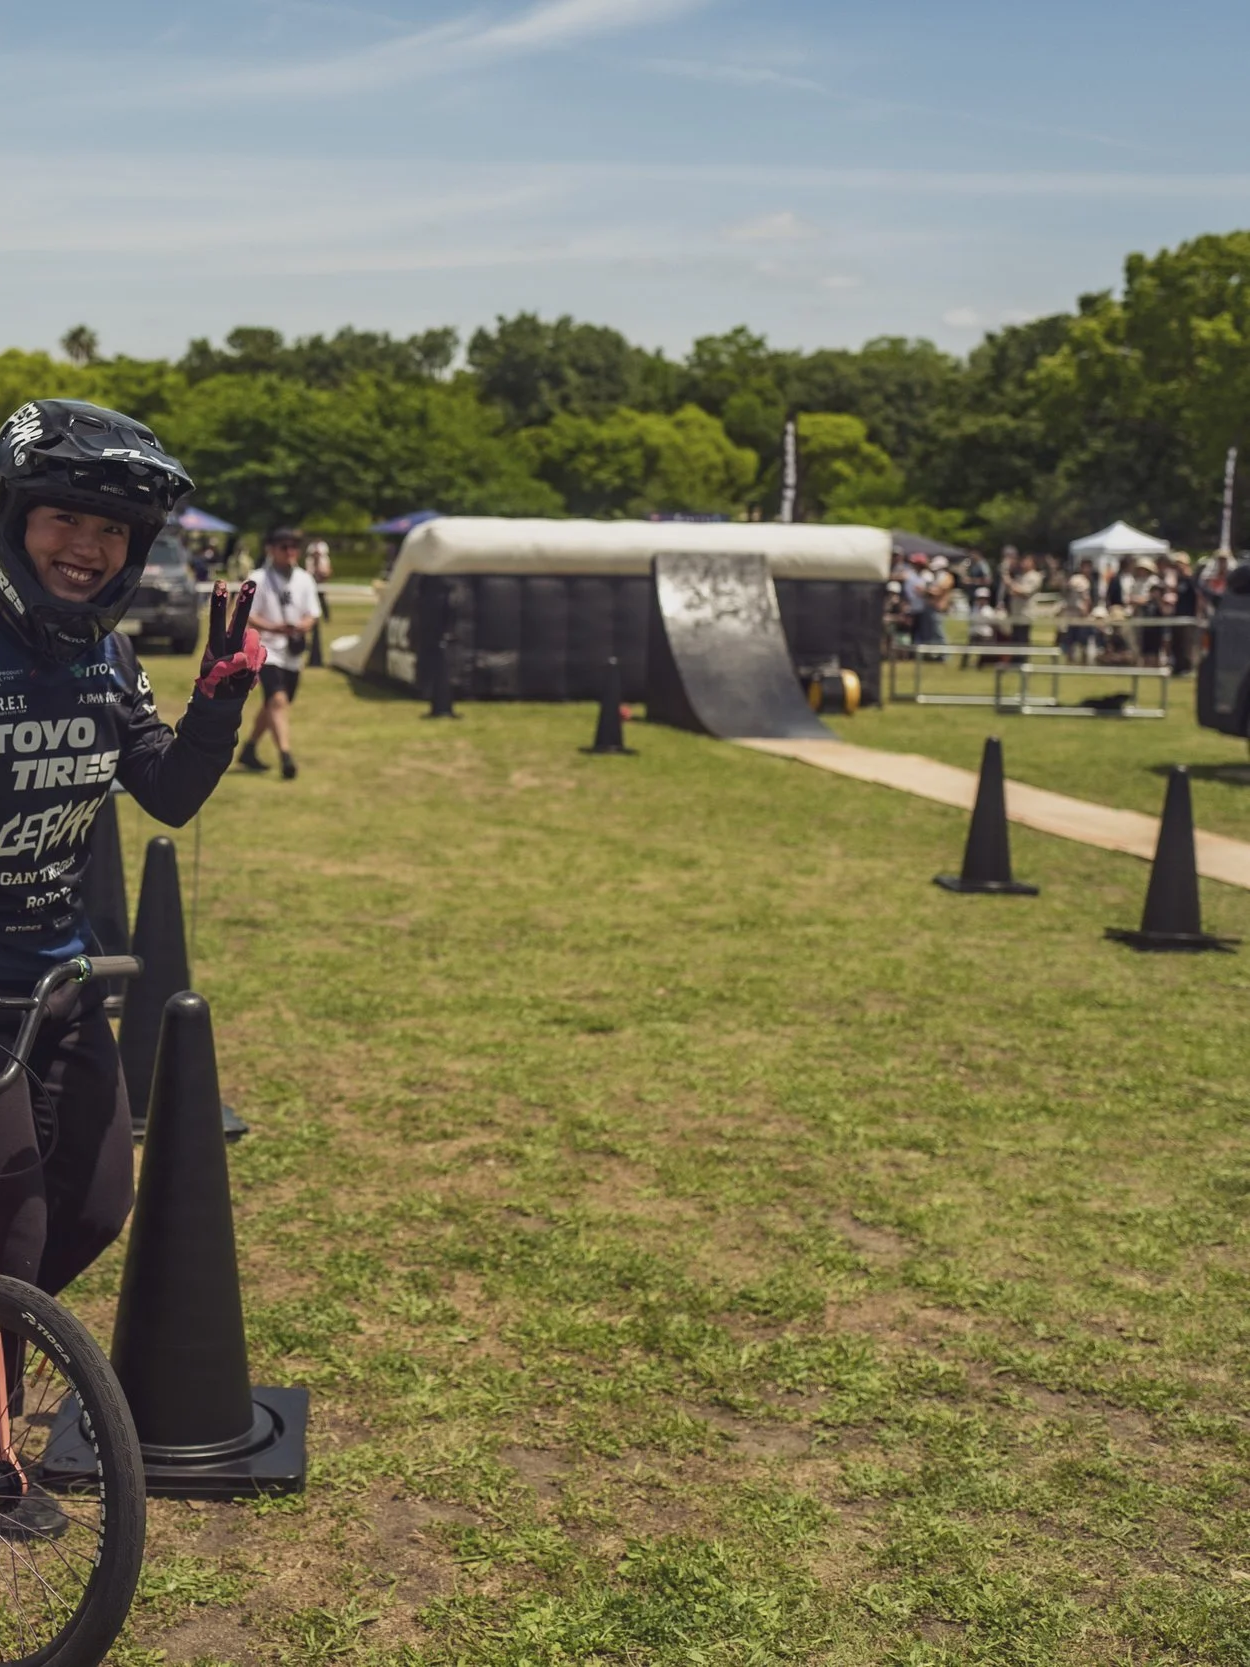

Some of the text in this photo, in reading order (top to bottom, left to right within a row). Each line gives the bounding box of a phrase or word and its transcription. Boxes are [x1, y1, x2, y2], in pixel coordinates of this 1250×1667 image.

[11, 749, 120, 791] TIRES
[0, 871, 38, 886] GAN
[35, 1323, 71, 1365] TIOGA
